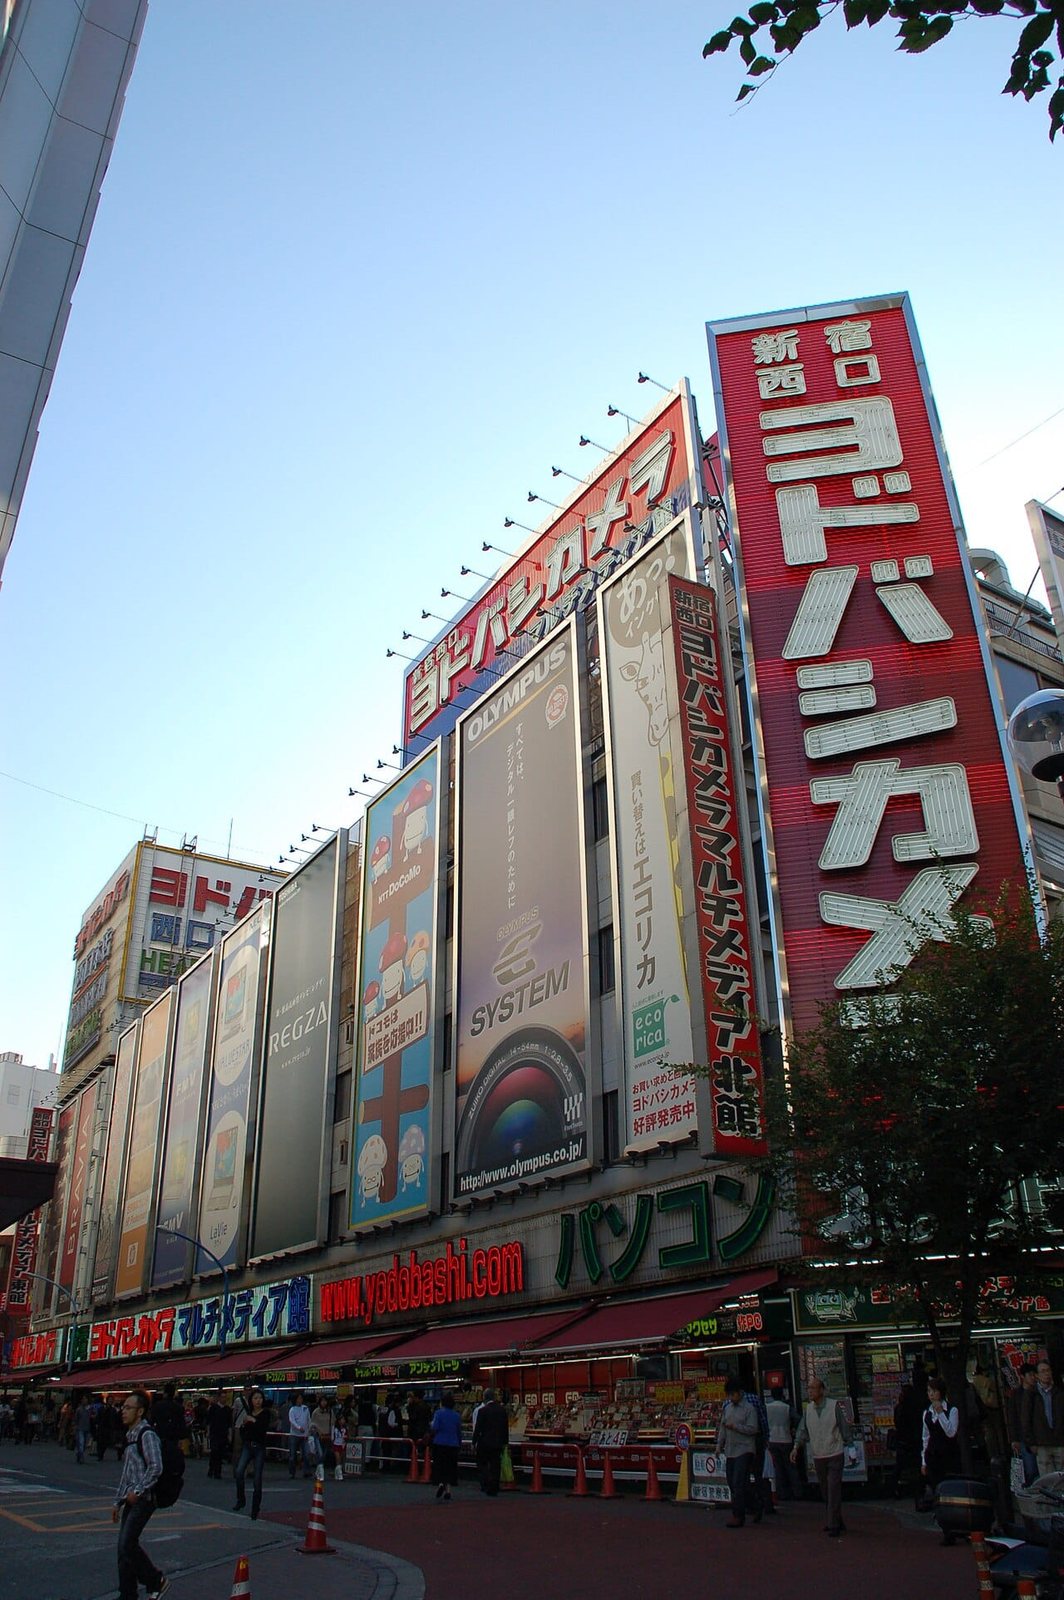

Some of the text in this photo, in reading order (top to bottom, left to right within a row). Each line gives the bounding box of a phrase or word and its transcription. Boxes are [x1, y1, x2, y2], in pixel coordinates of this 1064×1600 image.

[752, 320, 873, 365] 新宿
[754, 354, 882, 400] 西口
[410, 428, 677, 734] ヨドバシカメラ
[674, 587, 713, 614] 新宿
[675, 605, 714, 632] 西口
[467, 642, 567, 744] OLYMPUS
[632, 855, 657, 990] エコリカ
[469, 958, 571, 1038] SYSTEM
[635, 1008, 662, 1031] eco
[268, 1000, 328, 1057] REGZA
[635, 1028, 663, 1051] rica
[633, 1099, 695, 1137] 好評発売中
[459, 1137, 584, 1193] http://www.olympus.co.jp/
[555, 1172, 773, 1290] パソコン
[320, 1237, 524, 1326] www.yodobashi.com
[90, 1307, 177, 1361] ヨドバシカメラ
